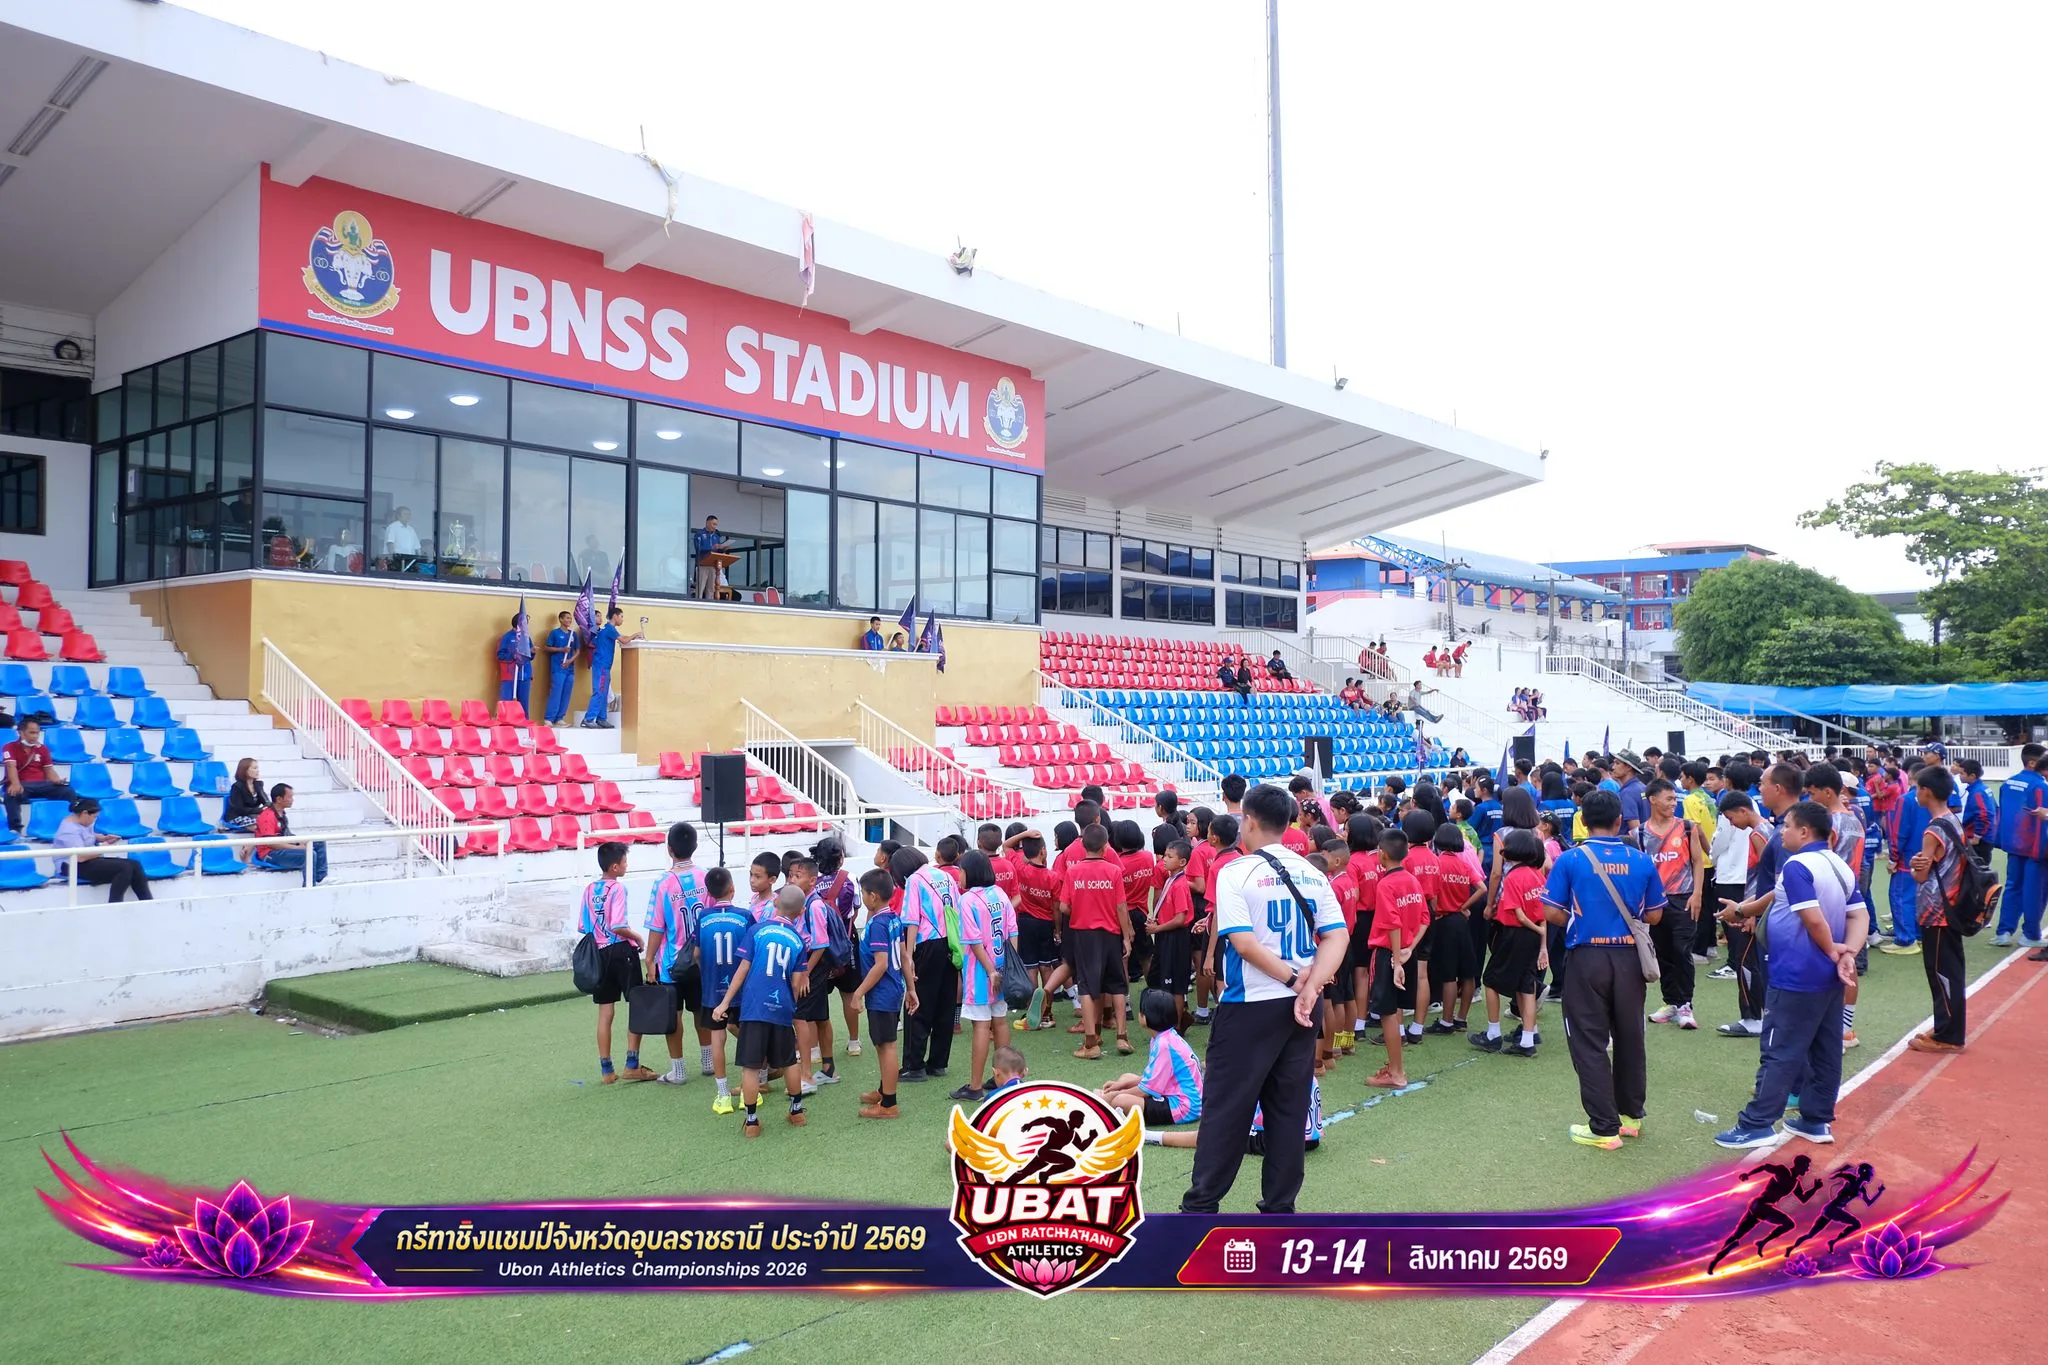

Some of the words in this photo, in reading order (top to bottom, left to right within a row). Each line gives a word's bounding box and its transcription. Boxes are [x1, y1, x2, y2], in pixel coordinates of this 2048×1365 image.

[429, 248, 689, 381] UBNSS
[724, 325, 970, 439] STADIUM
[1651, 851, 1679, 864] KNP
[1593, 862, 1629, 875] URIN
[1074, 880, 1086, 890] NM
[1087, 879, 1114, 890] SCHOOL
[1448, 874, 1470, 885] SCHOOL
[1029, 887, 1052, 899] SCHOOL
[991, 917, 1005, 956] 5
[714, 931, 733, 966] 11
[766, 941, 791, 980] 14
